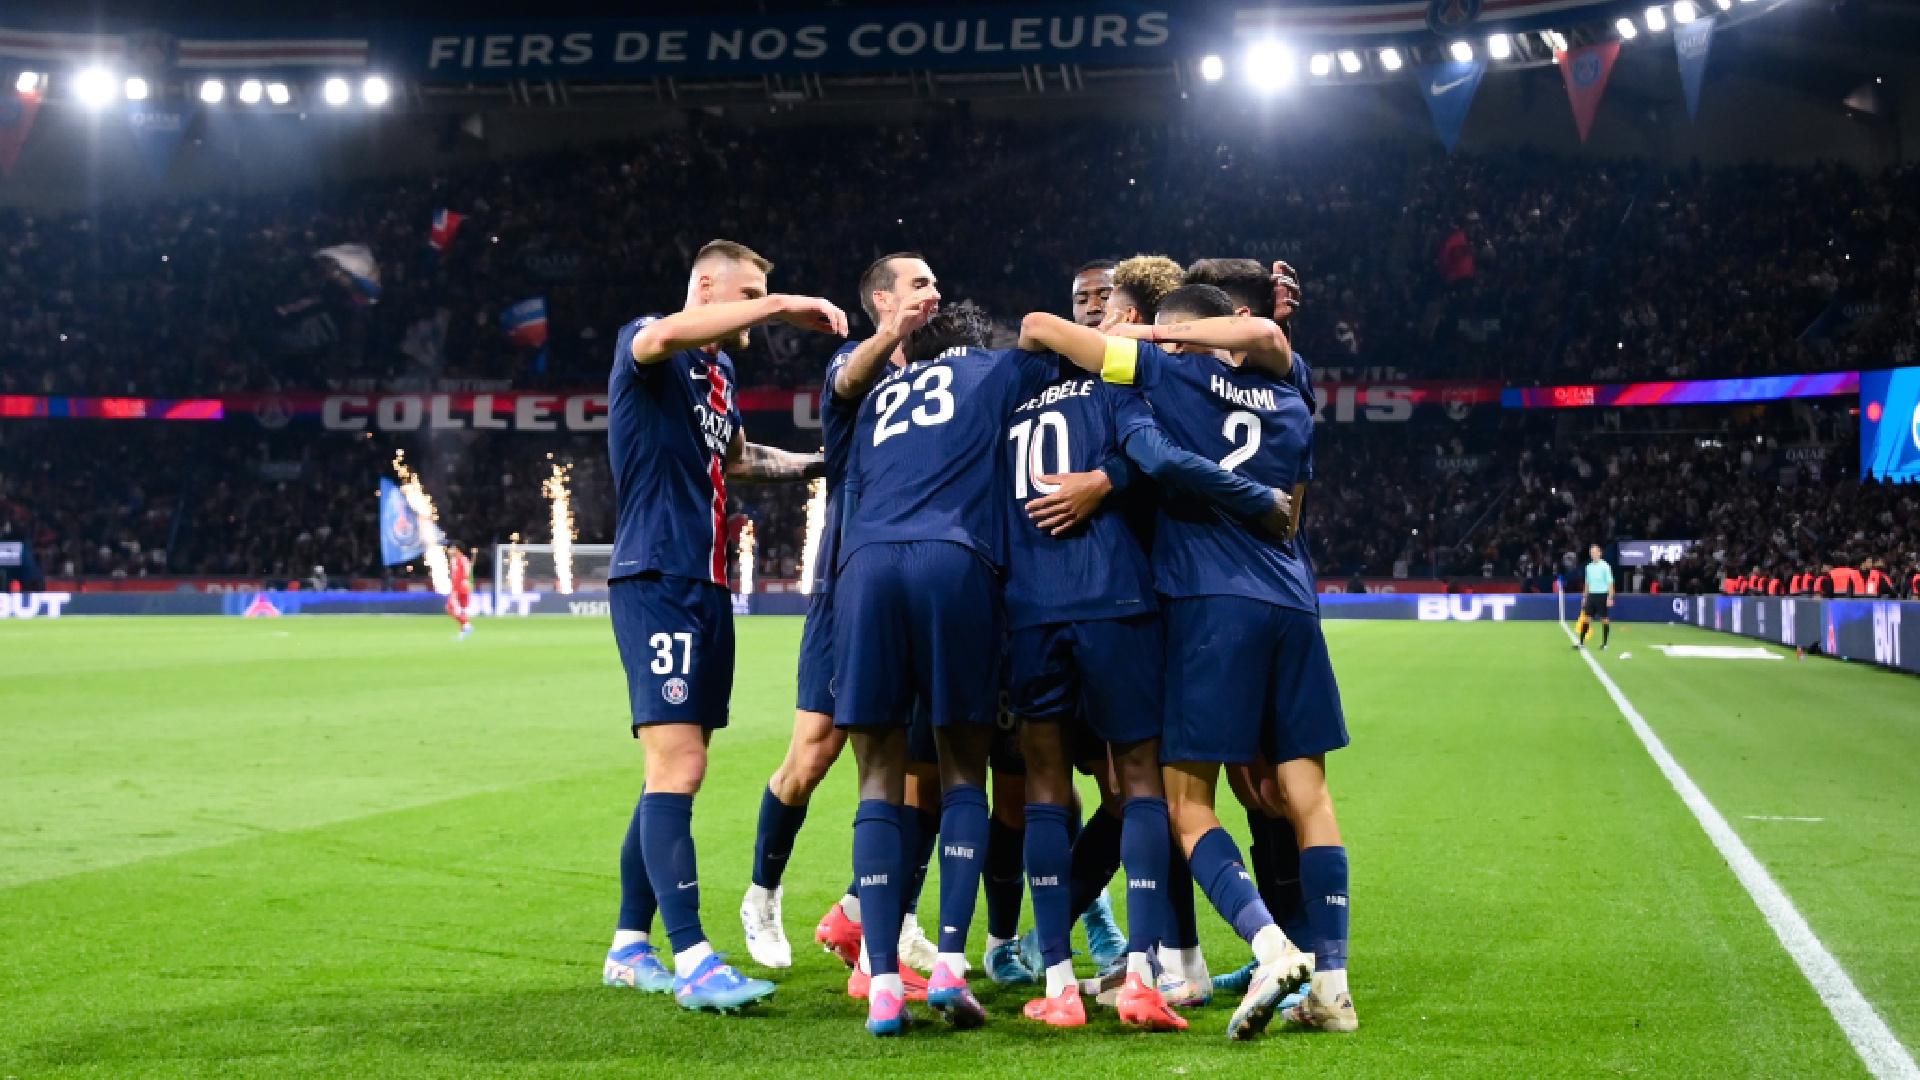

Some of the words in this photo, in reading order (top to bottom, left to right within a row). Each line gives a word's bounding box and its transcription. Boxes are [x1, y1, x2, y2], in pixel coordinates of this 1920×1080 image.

[430, 34, 592, 69] FIERS
[614, 31, 688, 62] DE
[708, 26, 828, 60] NOS
[848, 12, 1169, 57] COULEURS
[872, 365, 955, 447] 23
[1009, 411, 1070, 499] 10
[1220, 411, 1261, 473] 2
[1417, 594, 1516, 621] BUT
[649, 632, 692, 675] 37
